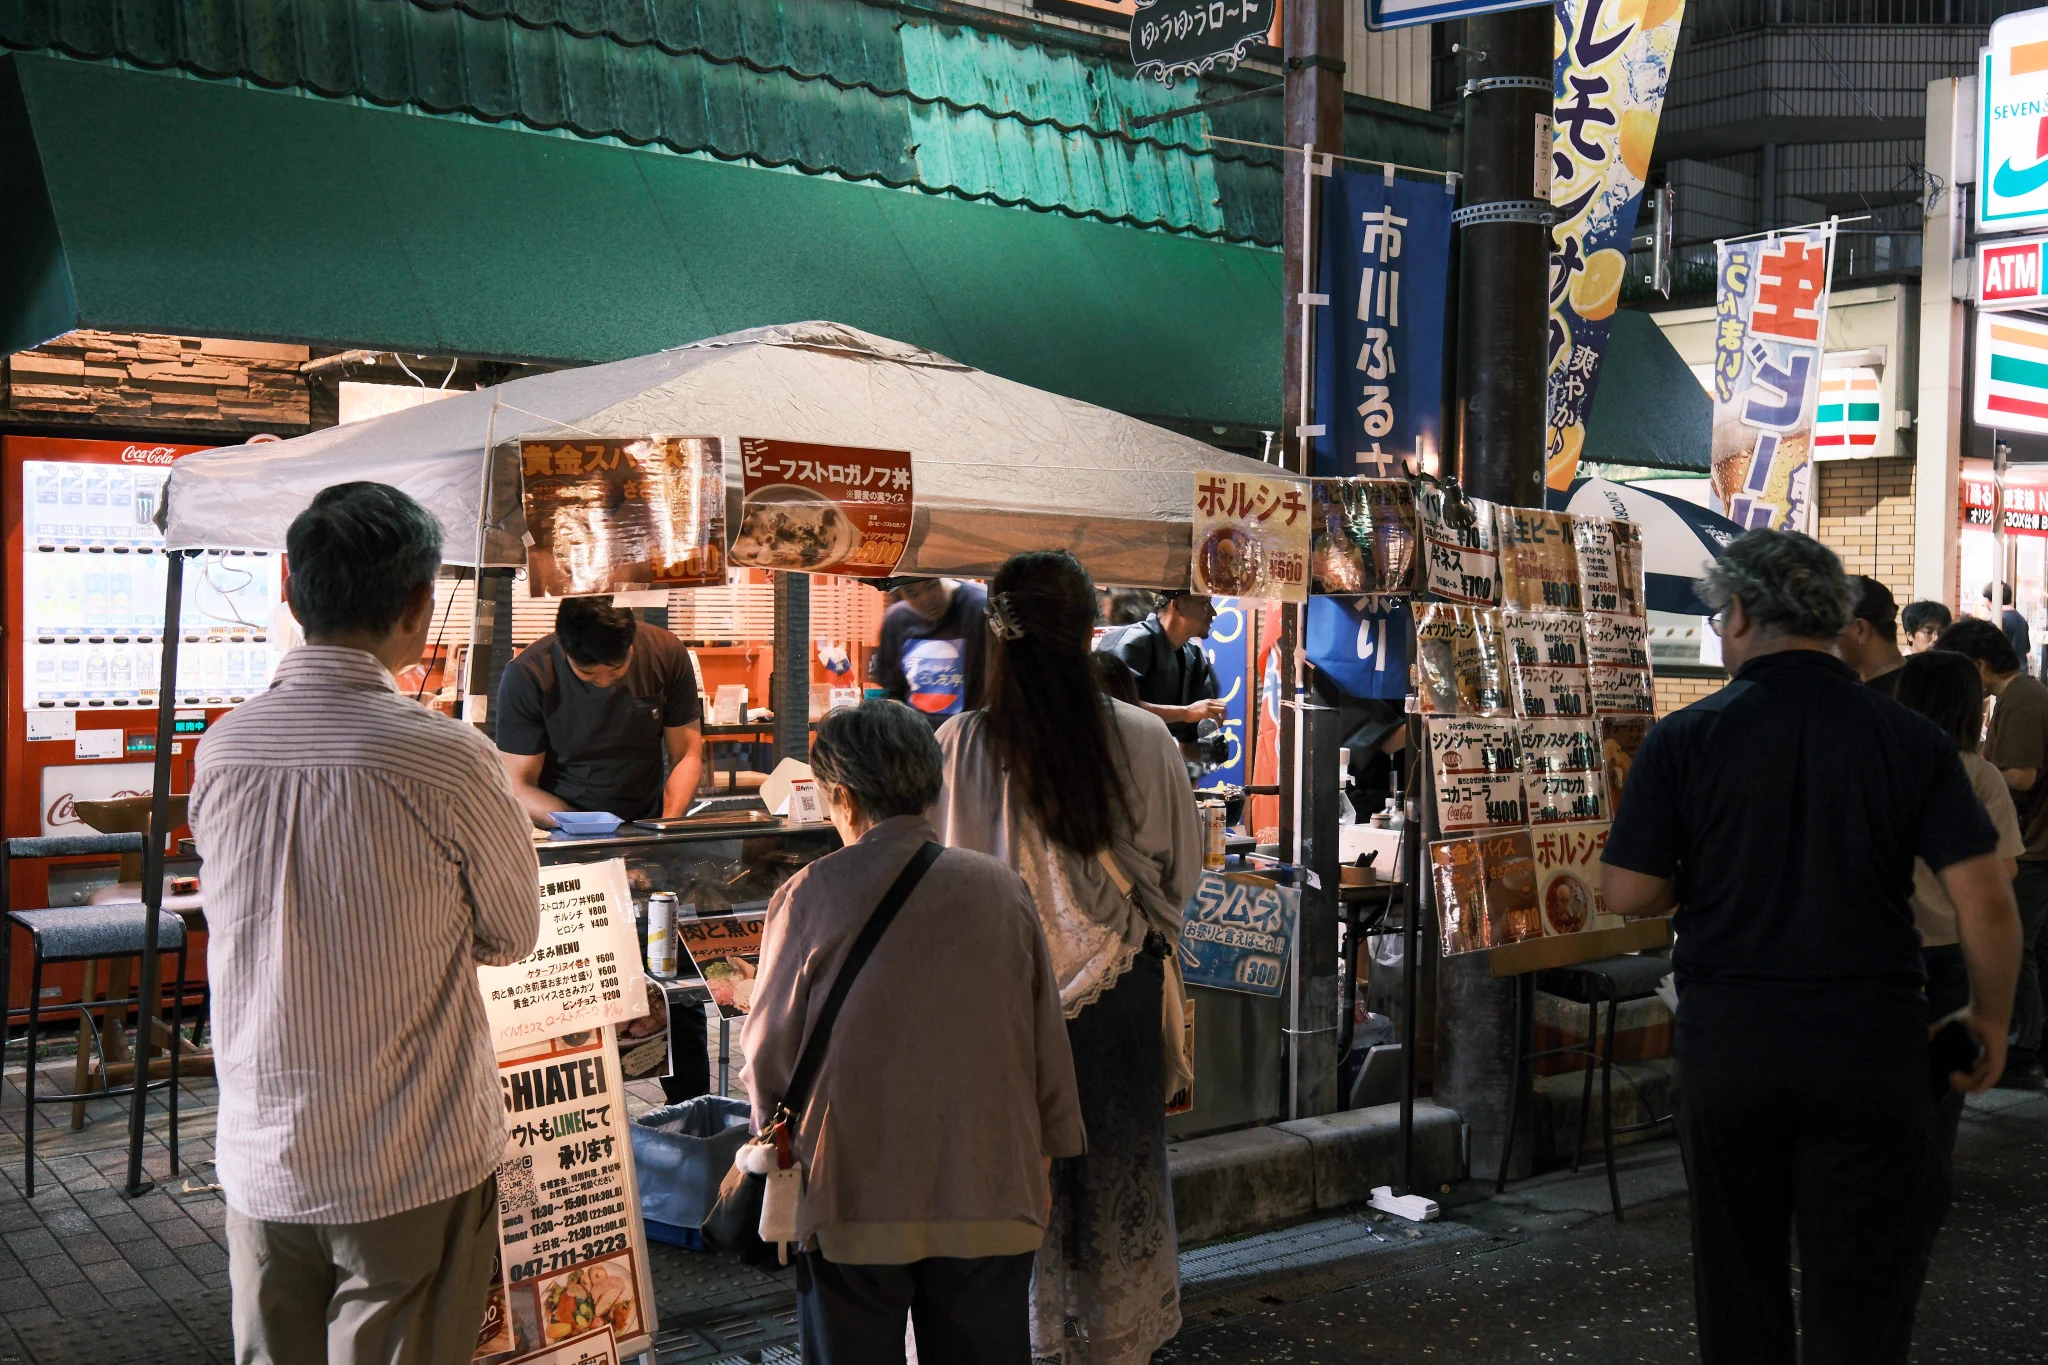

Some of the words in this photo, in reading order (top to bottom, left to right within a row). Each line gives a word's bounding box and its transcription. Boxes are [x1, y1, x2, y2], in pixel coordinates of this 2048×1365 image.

[1985, 252, 2036, 292] ATM
[743, 439, 769, 456] ミニ
[744, 455, 911, 491] ビーフストロガノフ丼
[1197, 476, 1307, 527] ボルシチ
[1513, 515, 1574, 545] 生ビール
[1460, 574, 1492, 599] ¥700
[1542, 582, 1580, 608] ¥600
[1547, 642, 1576, 664] ¥400
[1554, 693, 1582, 714] ¥400
[1432, 731, 1513, 750] ジンジャーエール
[1485, 800, 1519, 823] ¥400
[589, 905, 607, 916] ¥800
[1199, 881, 1280, 932] ラムネ
[591, 917, 609, 929] ¥400
[595, 952, 615, 964] ¥600
[598, 964, 617, 976] ¥600
[513, 983, 595, 1010] 黄金スパイスささみカツ
[600, 977, 619, 989] ¥300
[508, 1104, 611, 1148] ウトもLINEにて
[508, 1180, 523, 1189] LINE
[510, 1232, 627, 1283] 047-711-3223
